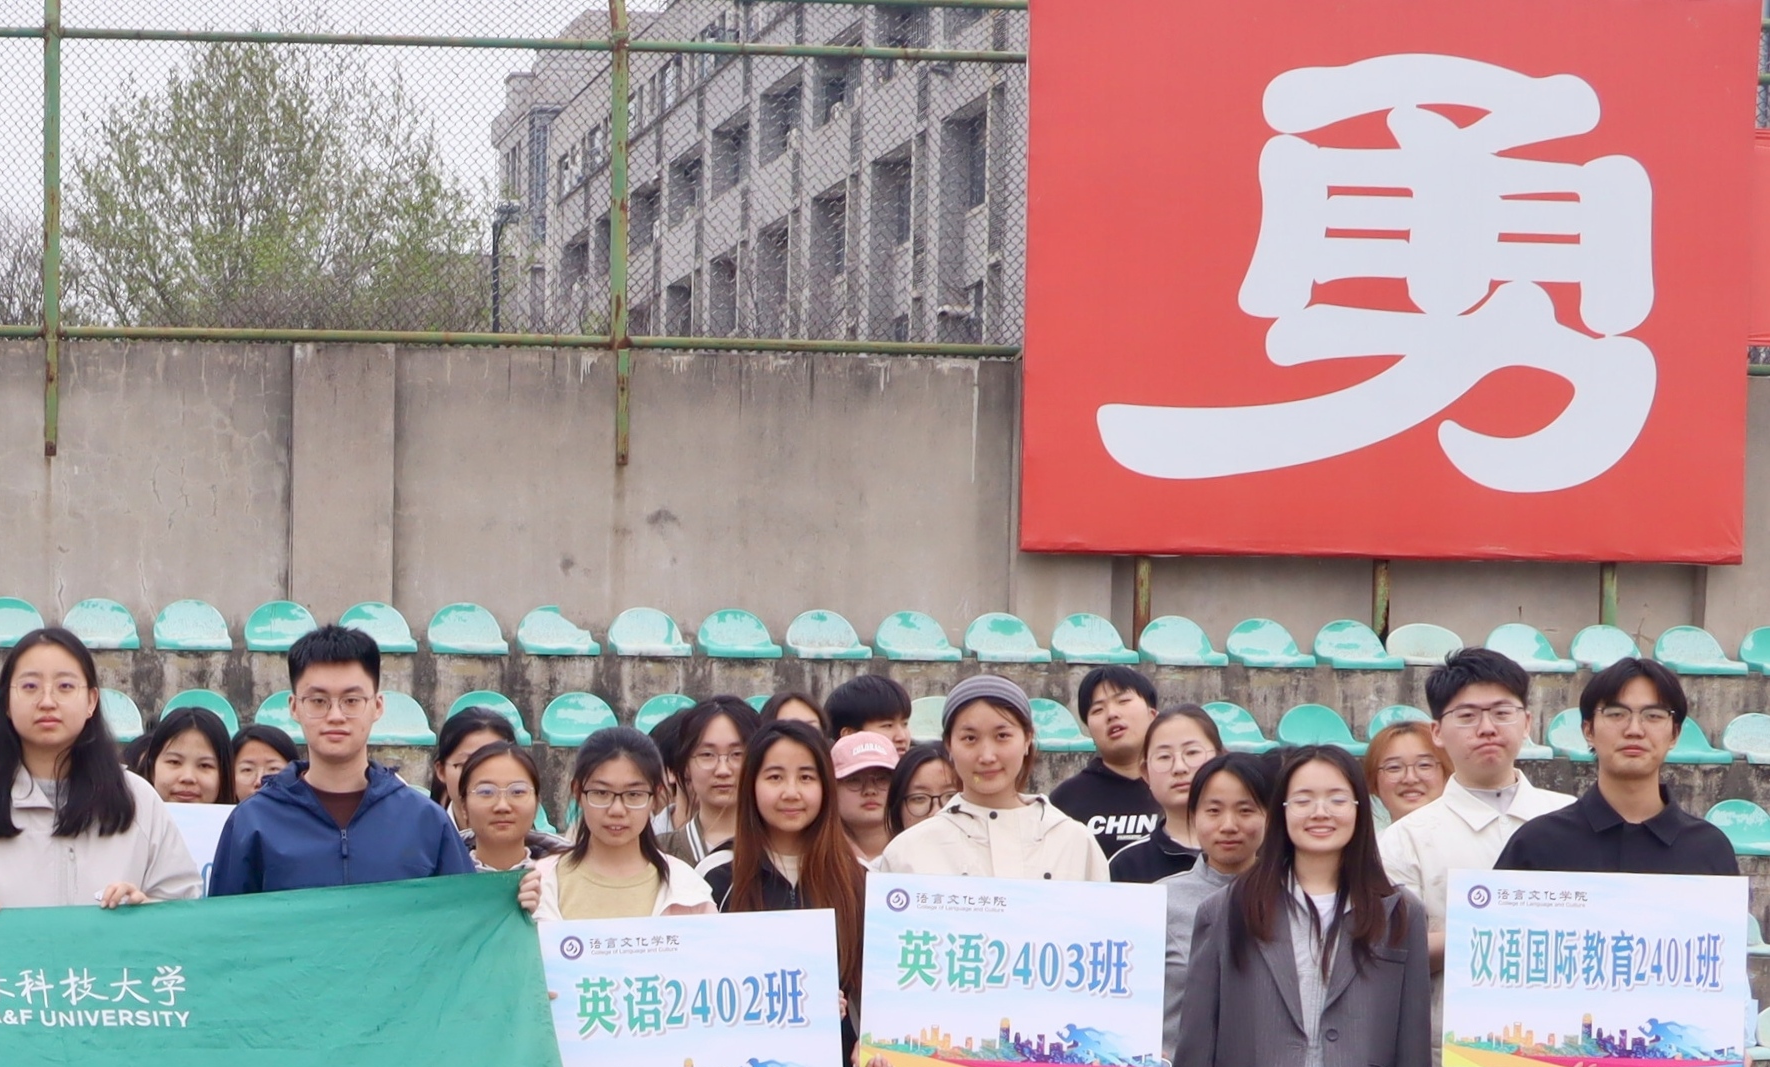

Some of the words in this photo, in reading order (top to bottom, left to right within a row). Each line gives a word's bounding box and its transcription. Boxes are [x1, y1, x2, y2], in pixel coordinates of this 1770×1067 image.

[1097, 53, 1656, 492] 勇
[916, 893, 1006, 906] 语言文化学院
[1498, 889, 1588, 901] 语言文化学院
[590, 935, 679, 949] 语言文化学院
[1470, 927, 1720, 988] 汉语国际教育2401班
[897, 930, 1128, 994] 英语2403班
[39, 1009, 189, 1027] UNIVERSITY
[576, 969, 804, 1036] 英语2402班
